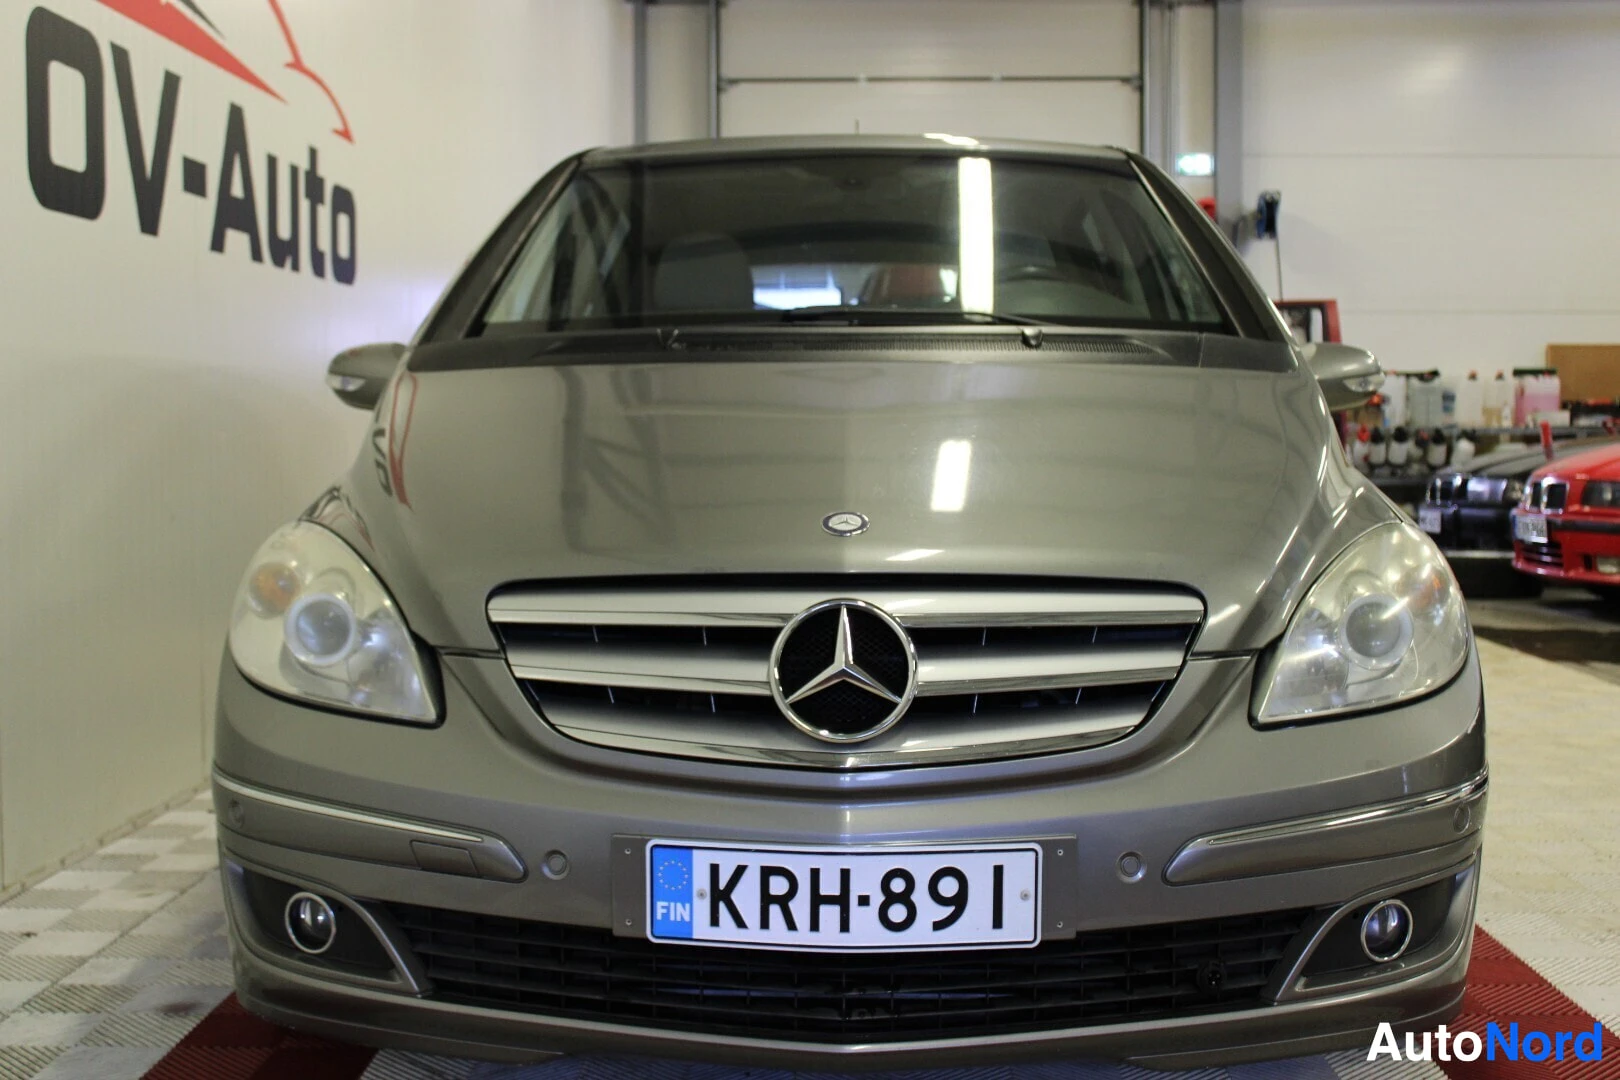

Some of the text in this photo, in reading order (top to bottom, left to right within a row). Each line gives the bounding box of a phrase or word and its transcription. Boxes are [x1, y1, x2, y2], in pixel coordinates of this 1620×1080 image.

[26, 6, 356, 286] OV-Auto
[656, 901, 691, 923] FIN
[709, 863, 1004, 933] KRH-891
